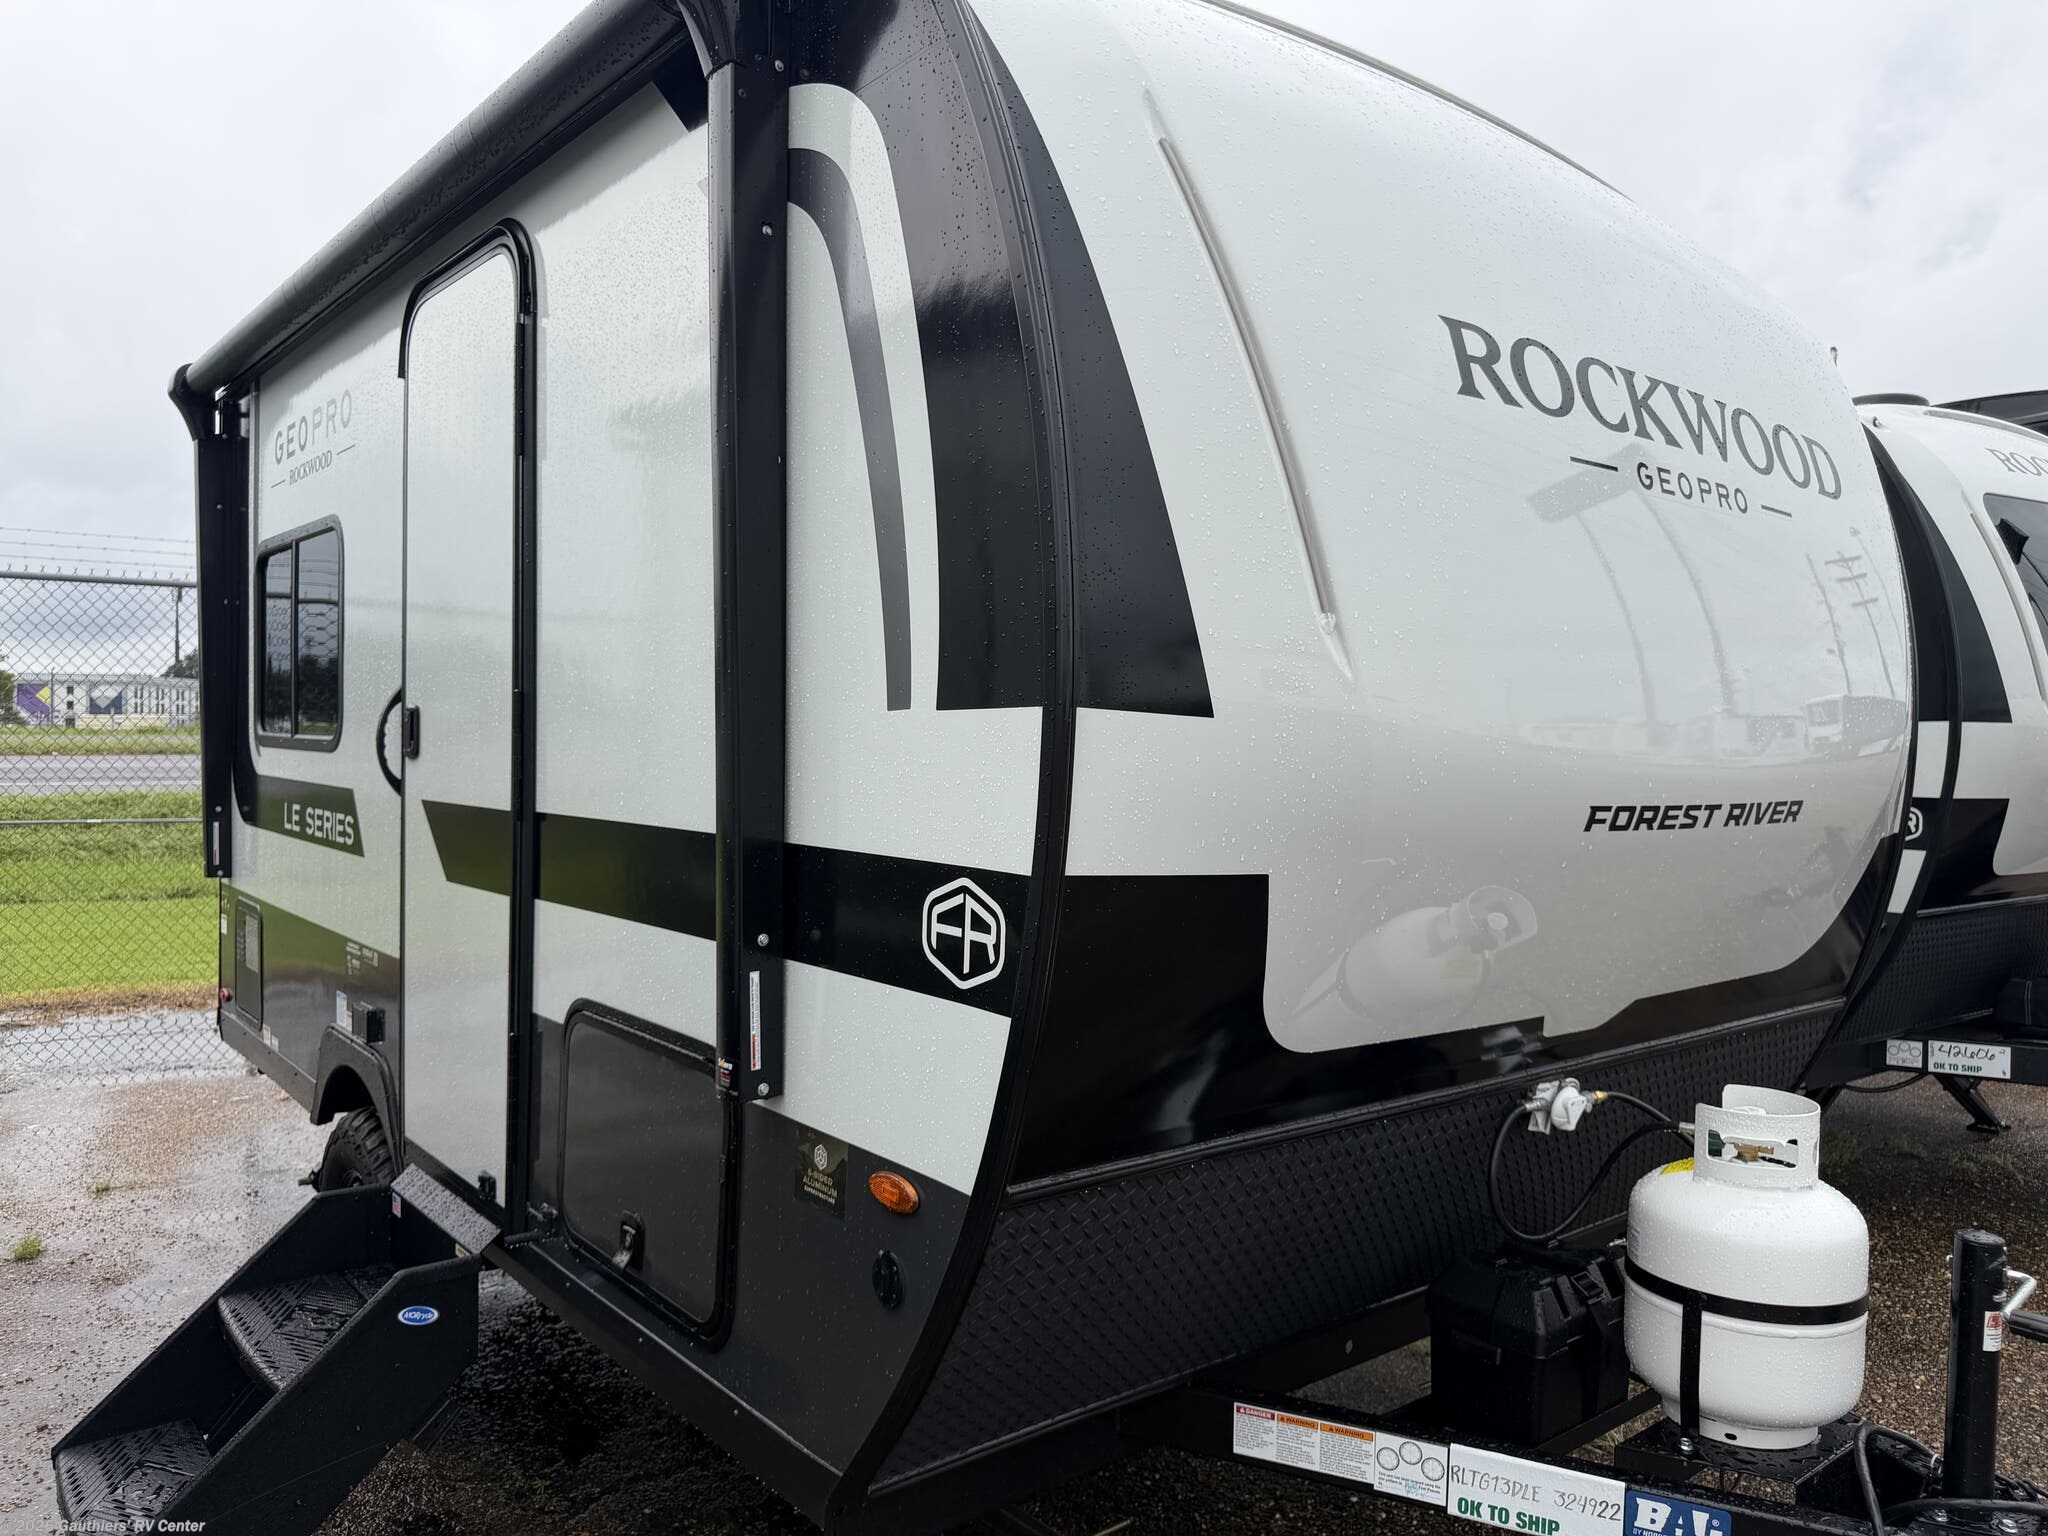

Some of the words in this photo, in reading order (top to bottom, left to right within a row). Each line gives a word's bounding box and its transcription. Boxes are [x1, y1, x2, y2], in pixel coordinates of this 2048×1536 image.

[1437, 313, 1843, 501] ROCKWOOD
[274, 388, 353, 465] GEOPRO
[289, 449, 333, 486] ROCKWOOD
[1636, 461, 1749, 515] GEOPRO
[284, 800, 301, 832] LE
[305, 806, 355, 846] SERIES
[1583, 803, 1722, 833] FOREST
[1723, 800, 1804, 828] RIVER
[1933, 1061, 1946, 1071] OK
[1948, 1062, 1959, 1072] TO
[1961, 1064, 1983, 1074] SHIP
[802, 1175, 838, 1198] ALUMINUM
[1245, 1407, 1272, 1419] DANGER
[1286, 1417, 1315, 1428] WARNING
[1335, 1426, 1364, 1439] WARNING
[1457, 1496, 1483, 1519] OK
[1487, 1503, 1510, 1525] TO
[1515, 1511, 1561, 1536] SHIP
[1553, 1489, 1622, 1522] 324922
